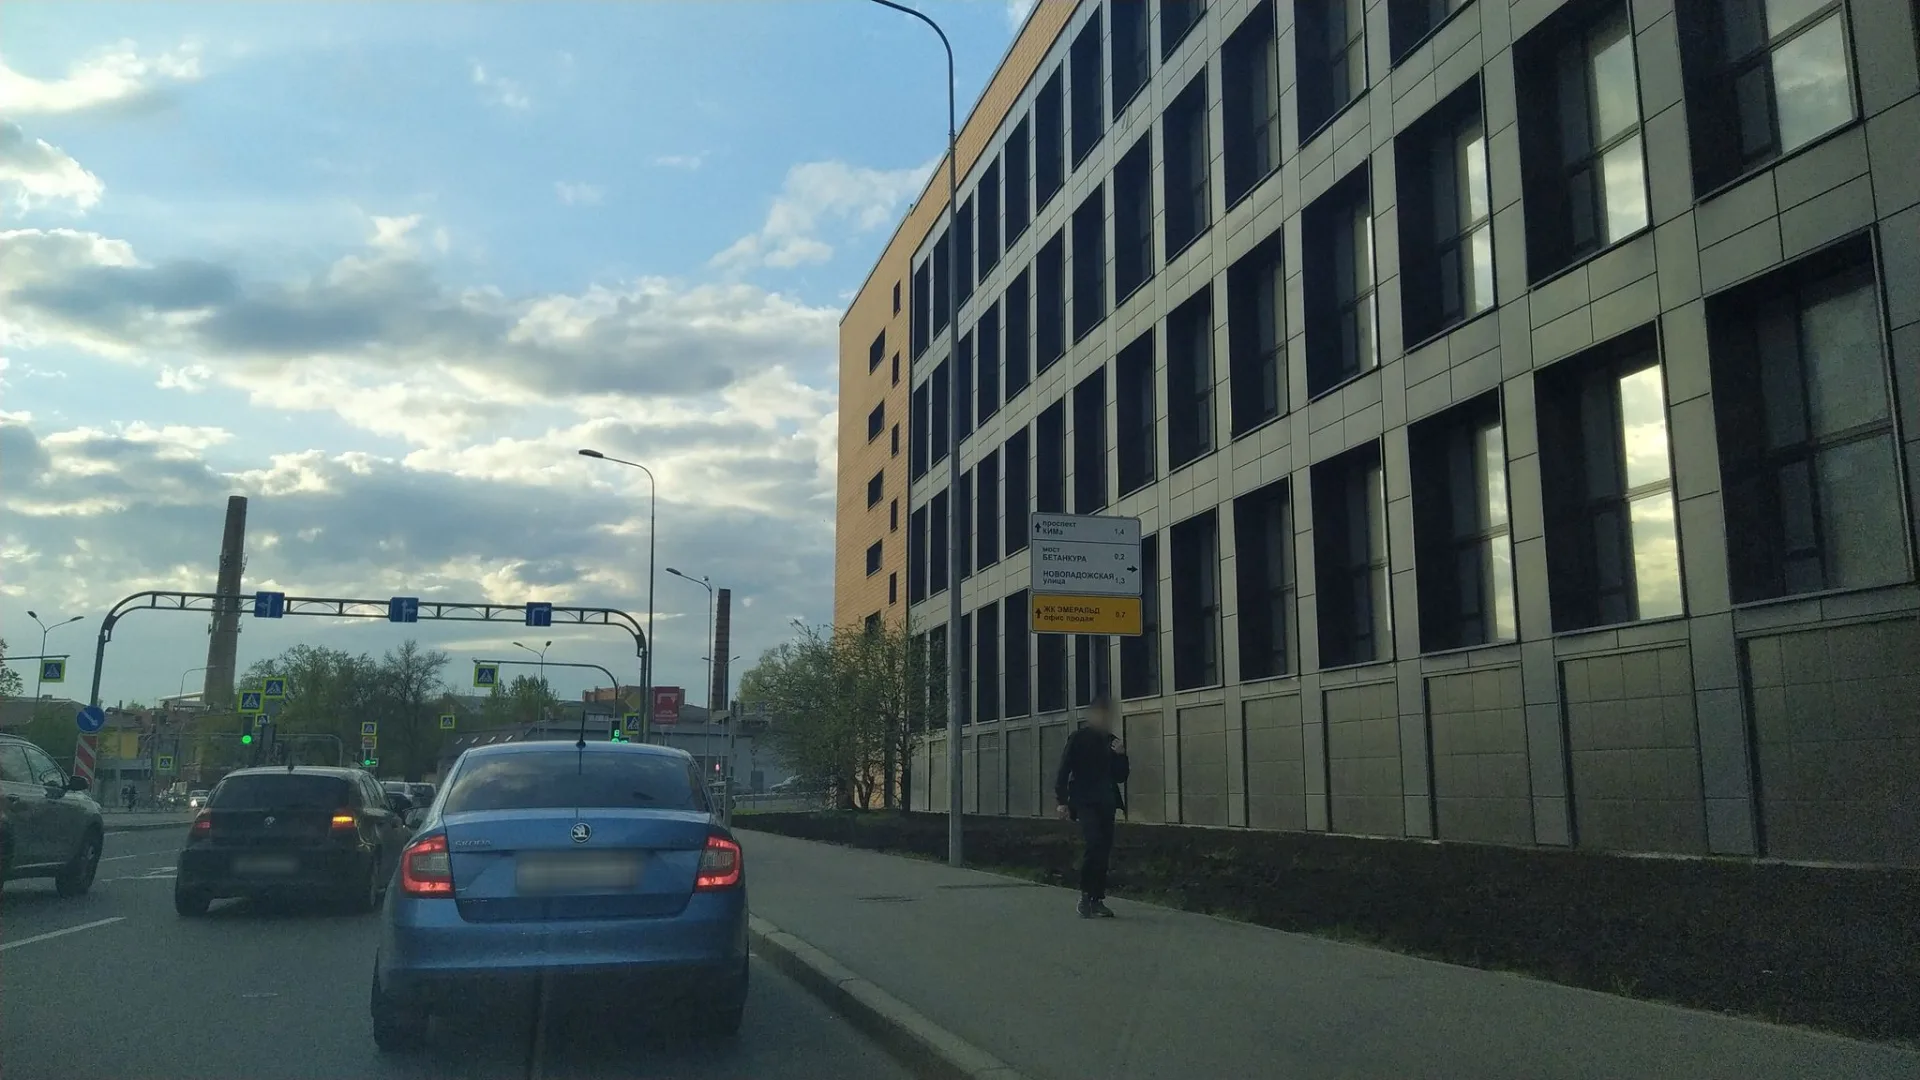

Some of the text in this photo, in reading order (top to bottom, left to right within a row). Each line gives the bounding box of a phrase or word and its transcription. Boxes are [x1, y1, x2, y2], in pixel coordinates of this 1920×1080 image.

[1042, 520, 1076, 528] проспект
[1042, 554, 1087, 562] БЕТАНКУРА
[1114, 553, 1125, 561] 0,2
[1043, 570, 1114, 580] НОВОЛАДОЖСКАЯ
[1057, 606, 1100, 615] ЭМЕРАЛЬД
[1043, 614, 1064, 622] офис
